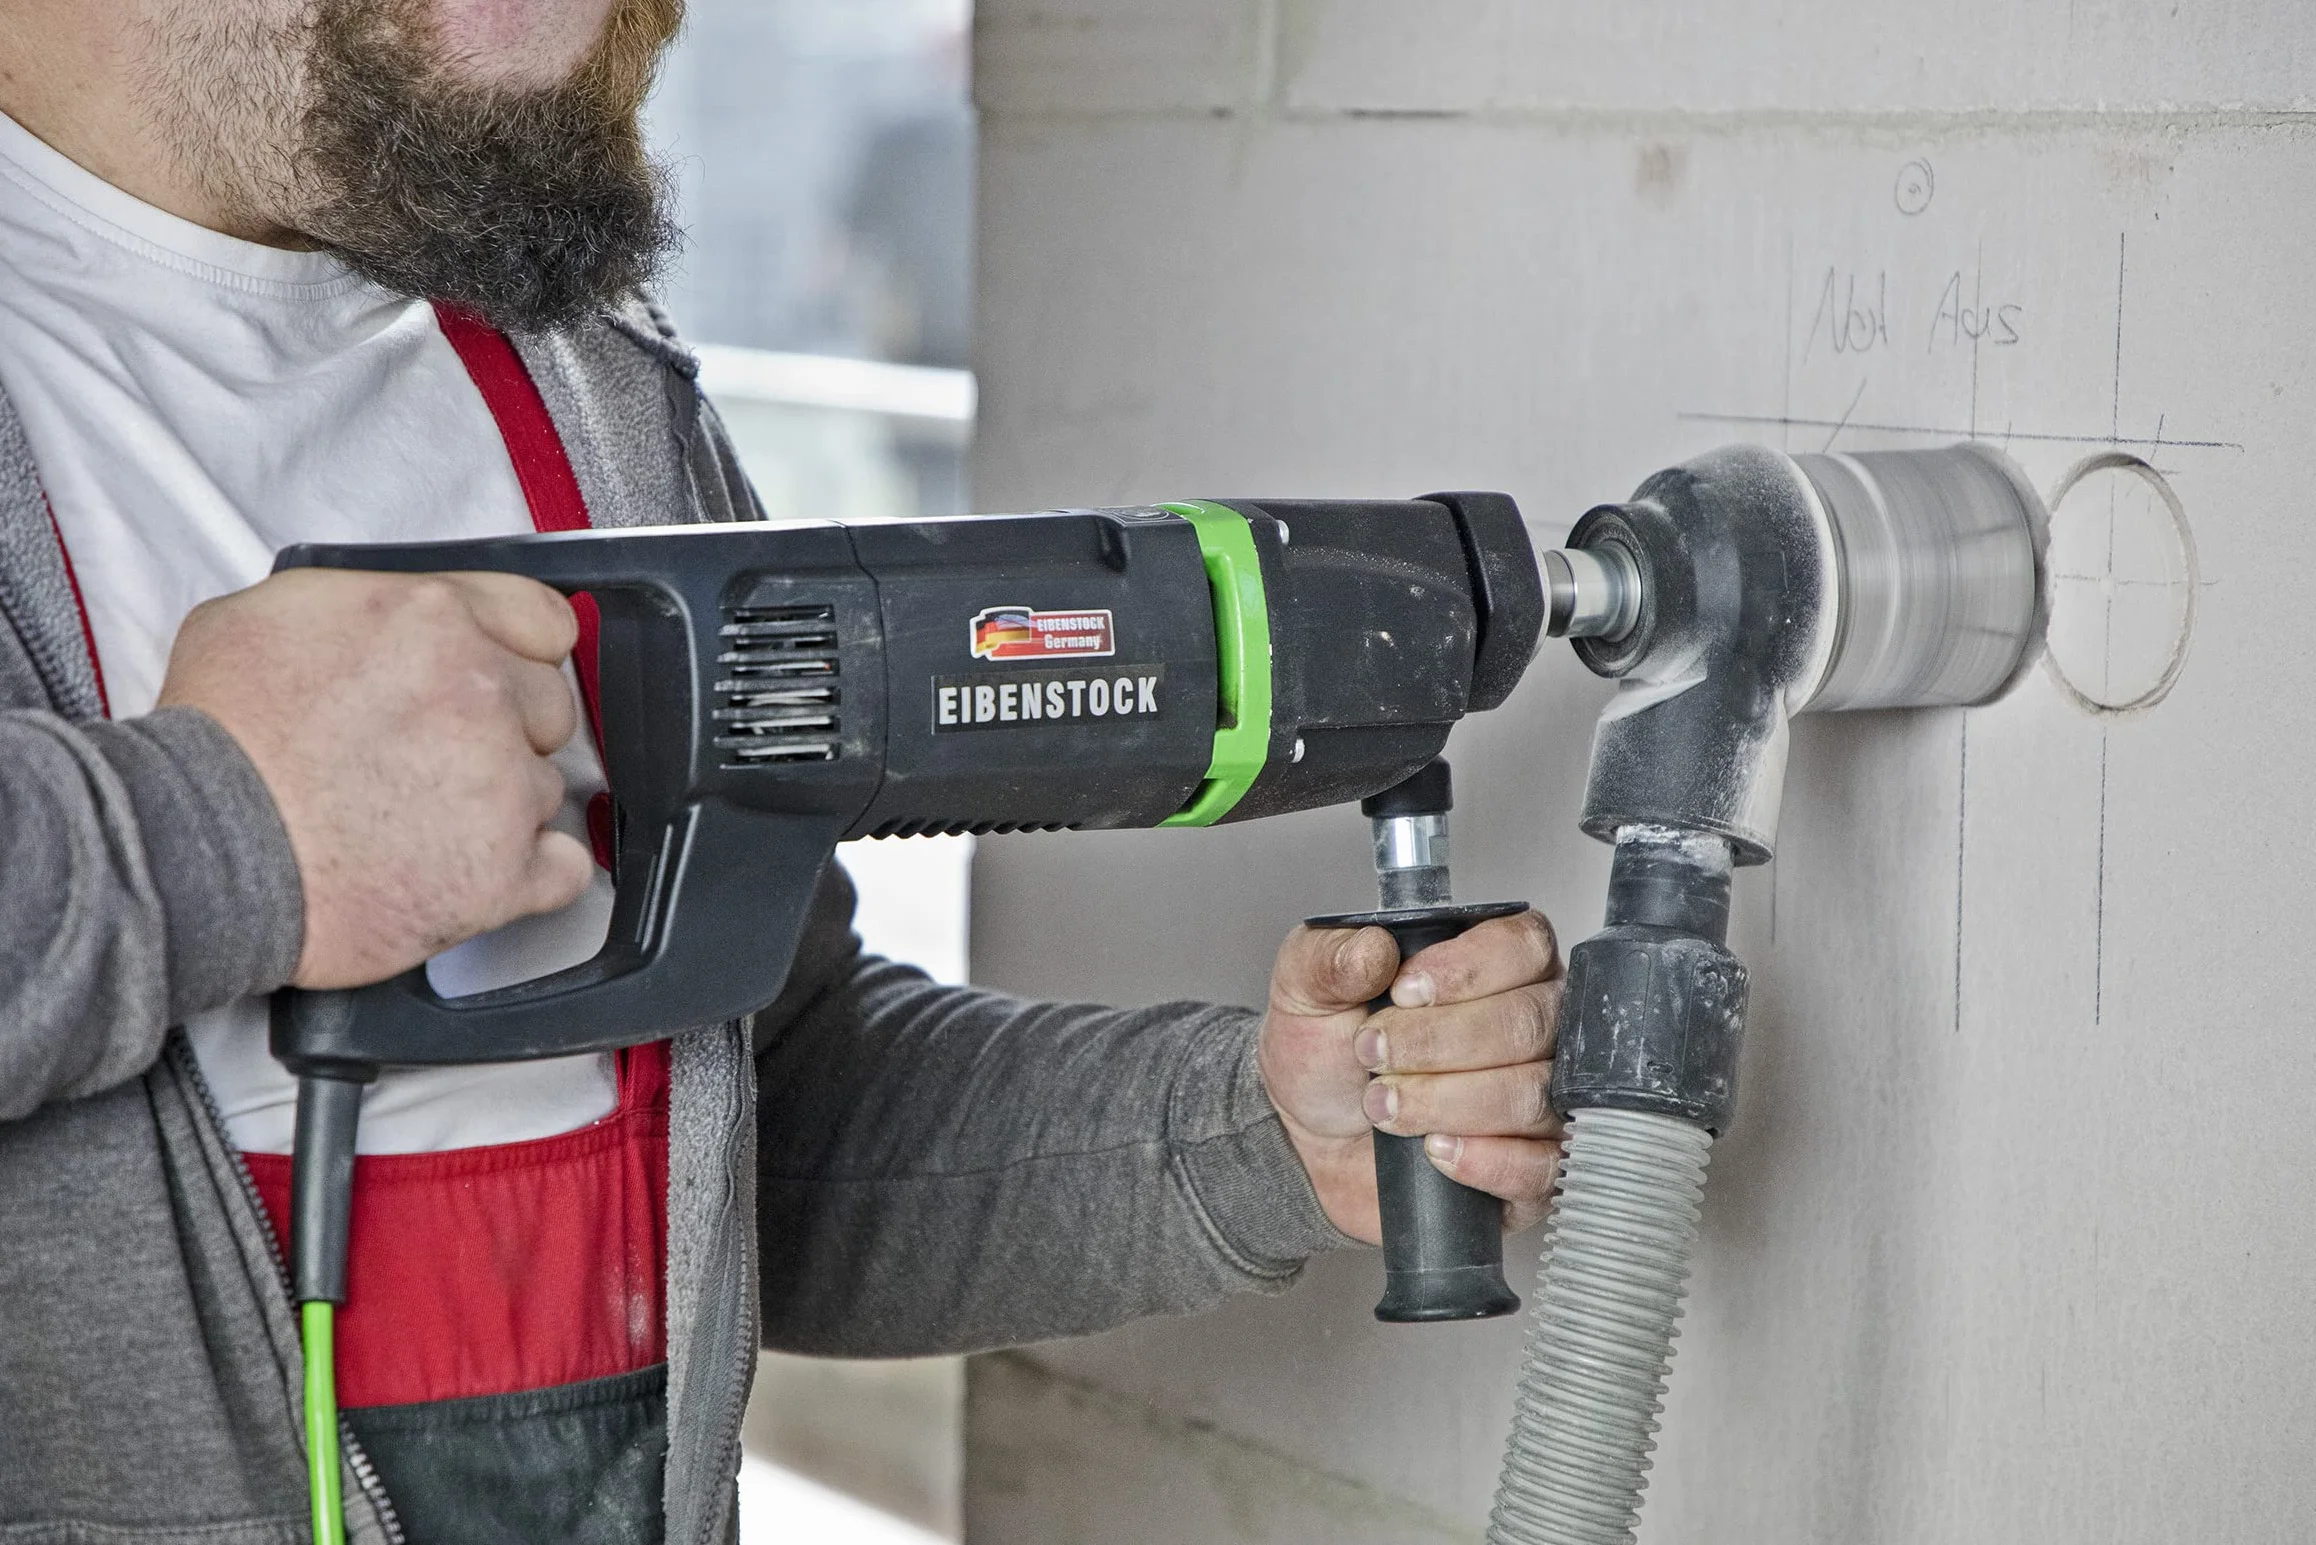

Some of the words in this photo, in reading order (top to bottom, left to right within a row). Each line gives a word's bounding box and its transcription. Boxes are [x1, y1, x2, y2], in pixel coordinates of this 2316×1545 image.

[1037, 616, 1106, 632] EIBENSTOCK
[1044, 634, 1101, 651] Germany
[938, 676, 1158, 725] EIBENSTOCK
